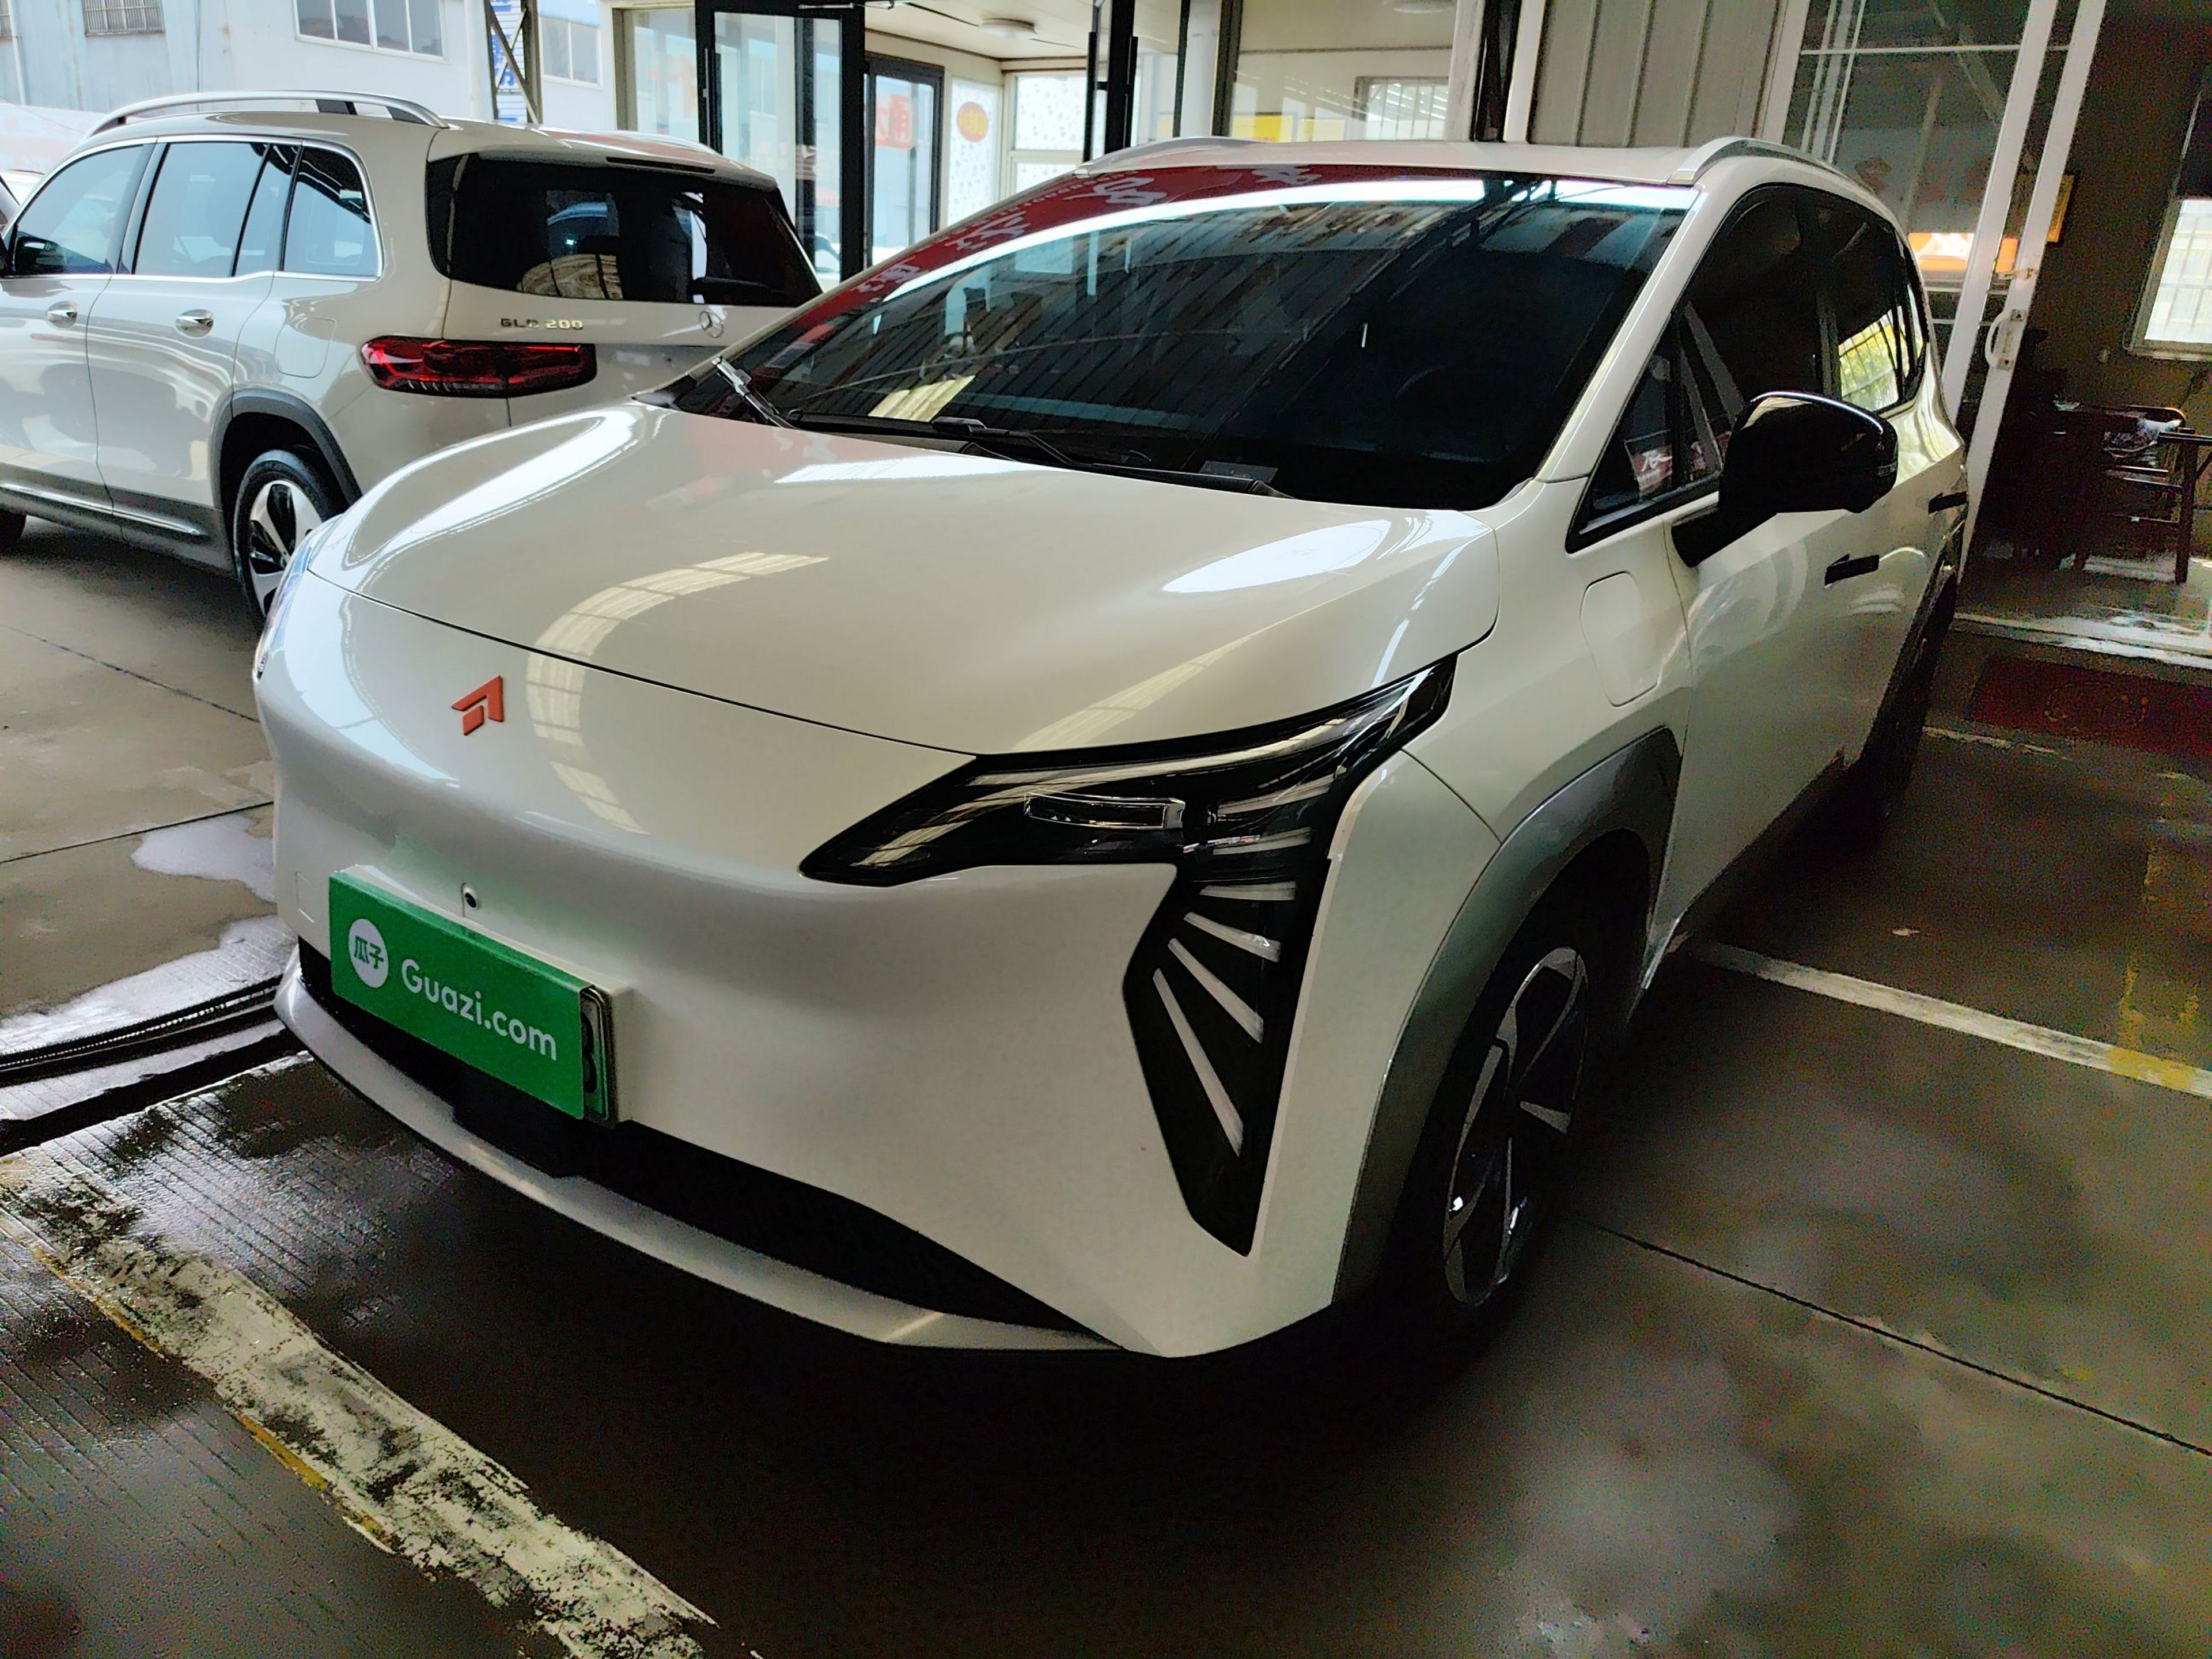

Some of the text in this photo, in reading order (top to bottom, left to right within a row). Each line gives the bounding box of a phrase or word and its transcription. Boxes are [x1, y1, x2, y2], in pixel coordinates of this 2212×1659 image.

[546, 319, 584, 330] 200
[354, 935, 385, 970] 瓜子
[402, 959, 557, 1061] Guazi.com
